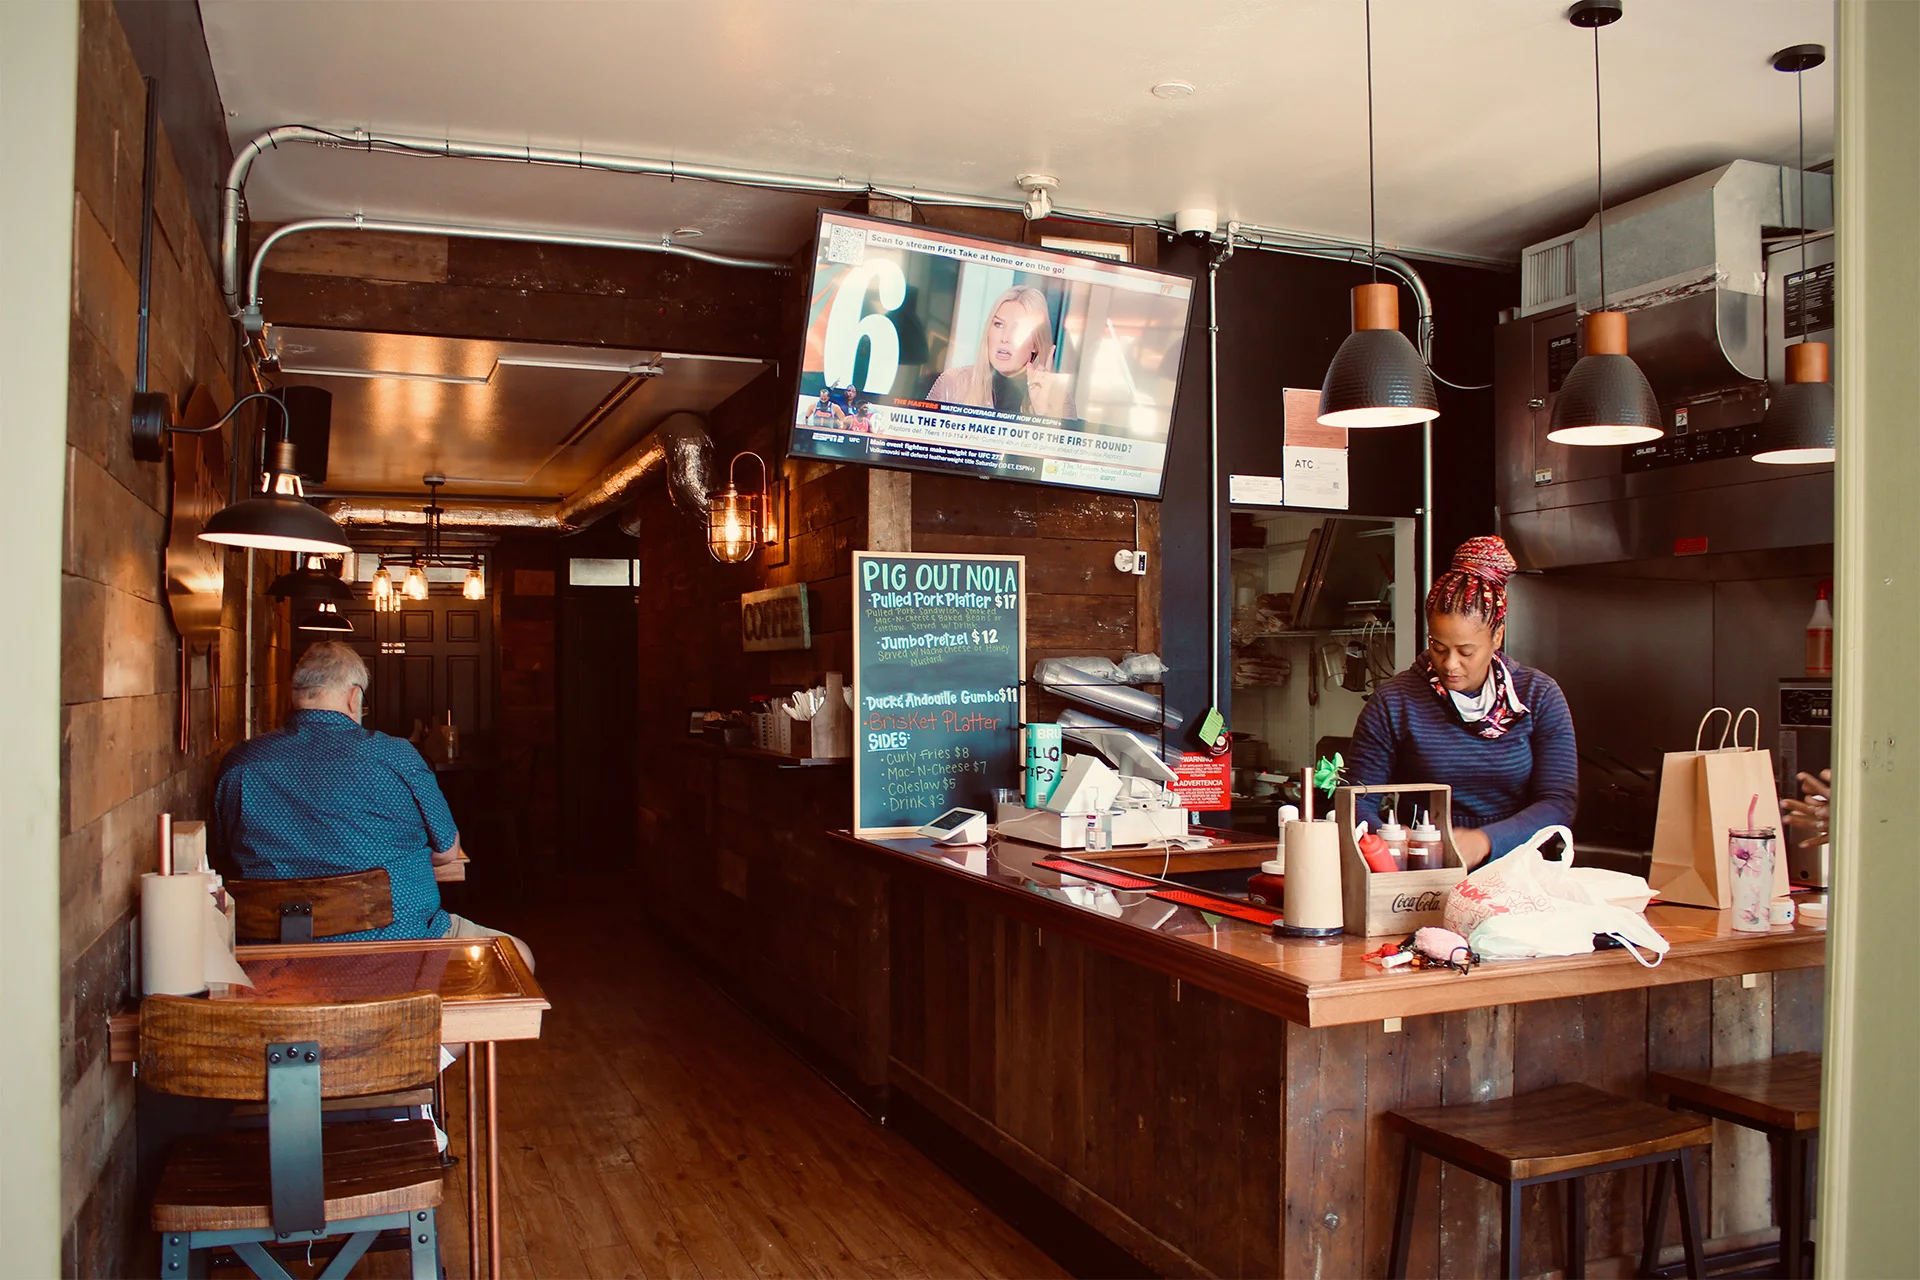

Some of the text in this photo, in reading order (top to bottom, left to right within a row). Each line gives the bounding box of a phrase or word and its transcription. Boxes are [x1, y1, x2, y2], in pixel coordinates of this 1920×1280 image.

[871, 233, 1065, 275] Scan to stream First Take at home or on the go!
[908, 399, 939, 410] MASTERS
[940, 404, 962, 413] WATCH
[963, 406, 996, 418] COVERAGE
[996, 411, 1016, 420] RIGHT
[1017, 415, 1032, 423] NOW
[1042, 418, 1062, 427] ESPN+
[888, 424, 911, 434] Raptors
[925, 429, 941, 437] 76ers
[890, 412, 1133, 454] WILL THE 76ers MAKE IT OUT OF THE FIRST ROUND?
[869, 438, 885, 448] Main
[886, 441, 904, 449] event
[904, 443, 929, 453] fighters
[930, 446, 946, 455] make
[947, 448, 967, 458] weight
[968, 449, 977, 458] for
[978, 451, 991, 460] UFC
[901, 449, 910, 457] will
[910, 450, 928, 459] defend
[929, 453, 964, 465] featherweight
[975, 459, 998, 469] Saturday
[1294, 459, 1314, 469] ATC
[863, 560, 1017, 593] PIG OUT NOLA
[871, 592, 1017, 609] Pulled Pork Platter $17
[865, 608, 894, 618] Pulled
[896, 607, 915, 616] Pork
[965, 607, 997, 616] Smoked
[938, 614, 963, 622] Baked
[966, 613, 991, 622] Beans
[911, 622, 936, 631] Served
[881, 629, 999, 651] Jumbo Pretzel $12
[877, 648, 907, 662] Served
[920, 646, 943, 656] Nacho
[943, 644, 971, 653] Cheese
[974, 643, 982, 652] or
[985, 644, 1011, 656] Honey
[905, 690, 958, 708] Andouille
[960, 690, 1000, 704] Gumbo
[998, 687, 1018, 703] $11
[868, 732, 911, 751] SIDES:
[886, 746, 970, 767] Curly Fries $8
[972, 760, 987, 775] $7
[887, 776, 956, 796] Coleslaw $5
[1179, 779, 1223, 787] ADVERTENCIA
[889, 793, 945, 812] Drink $3
[1391, 890, 1443, 914] Coca-Cola
